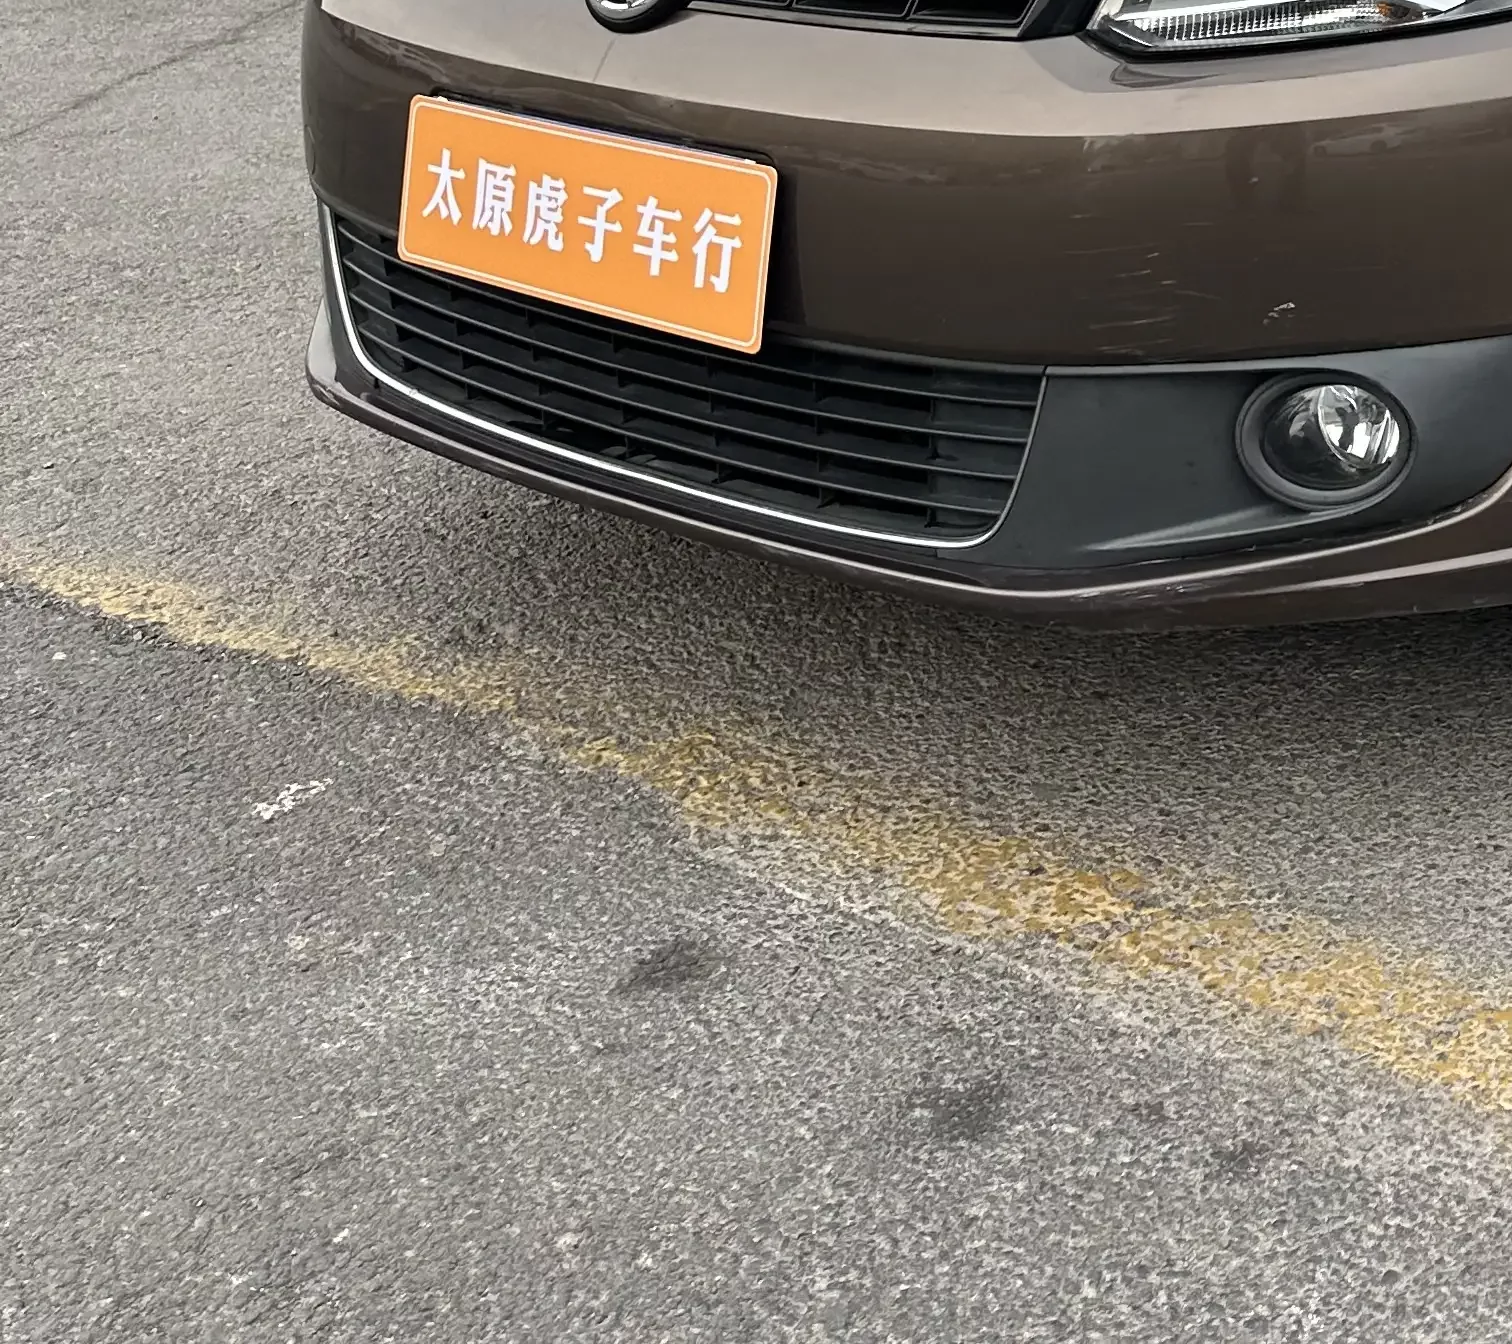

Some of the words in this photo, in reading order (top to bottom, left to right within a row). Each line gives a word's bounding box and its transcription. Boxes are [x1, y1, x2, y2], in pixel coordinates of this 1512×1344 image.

[421, 147, 743, 294] 太原虎子车行
